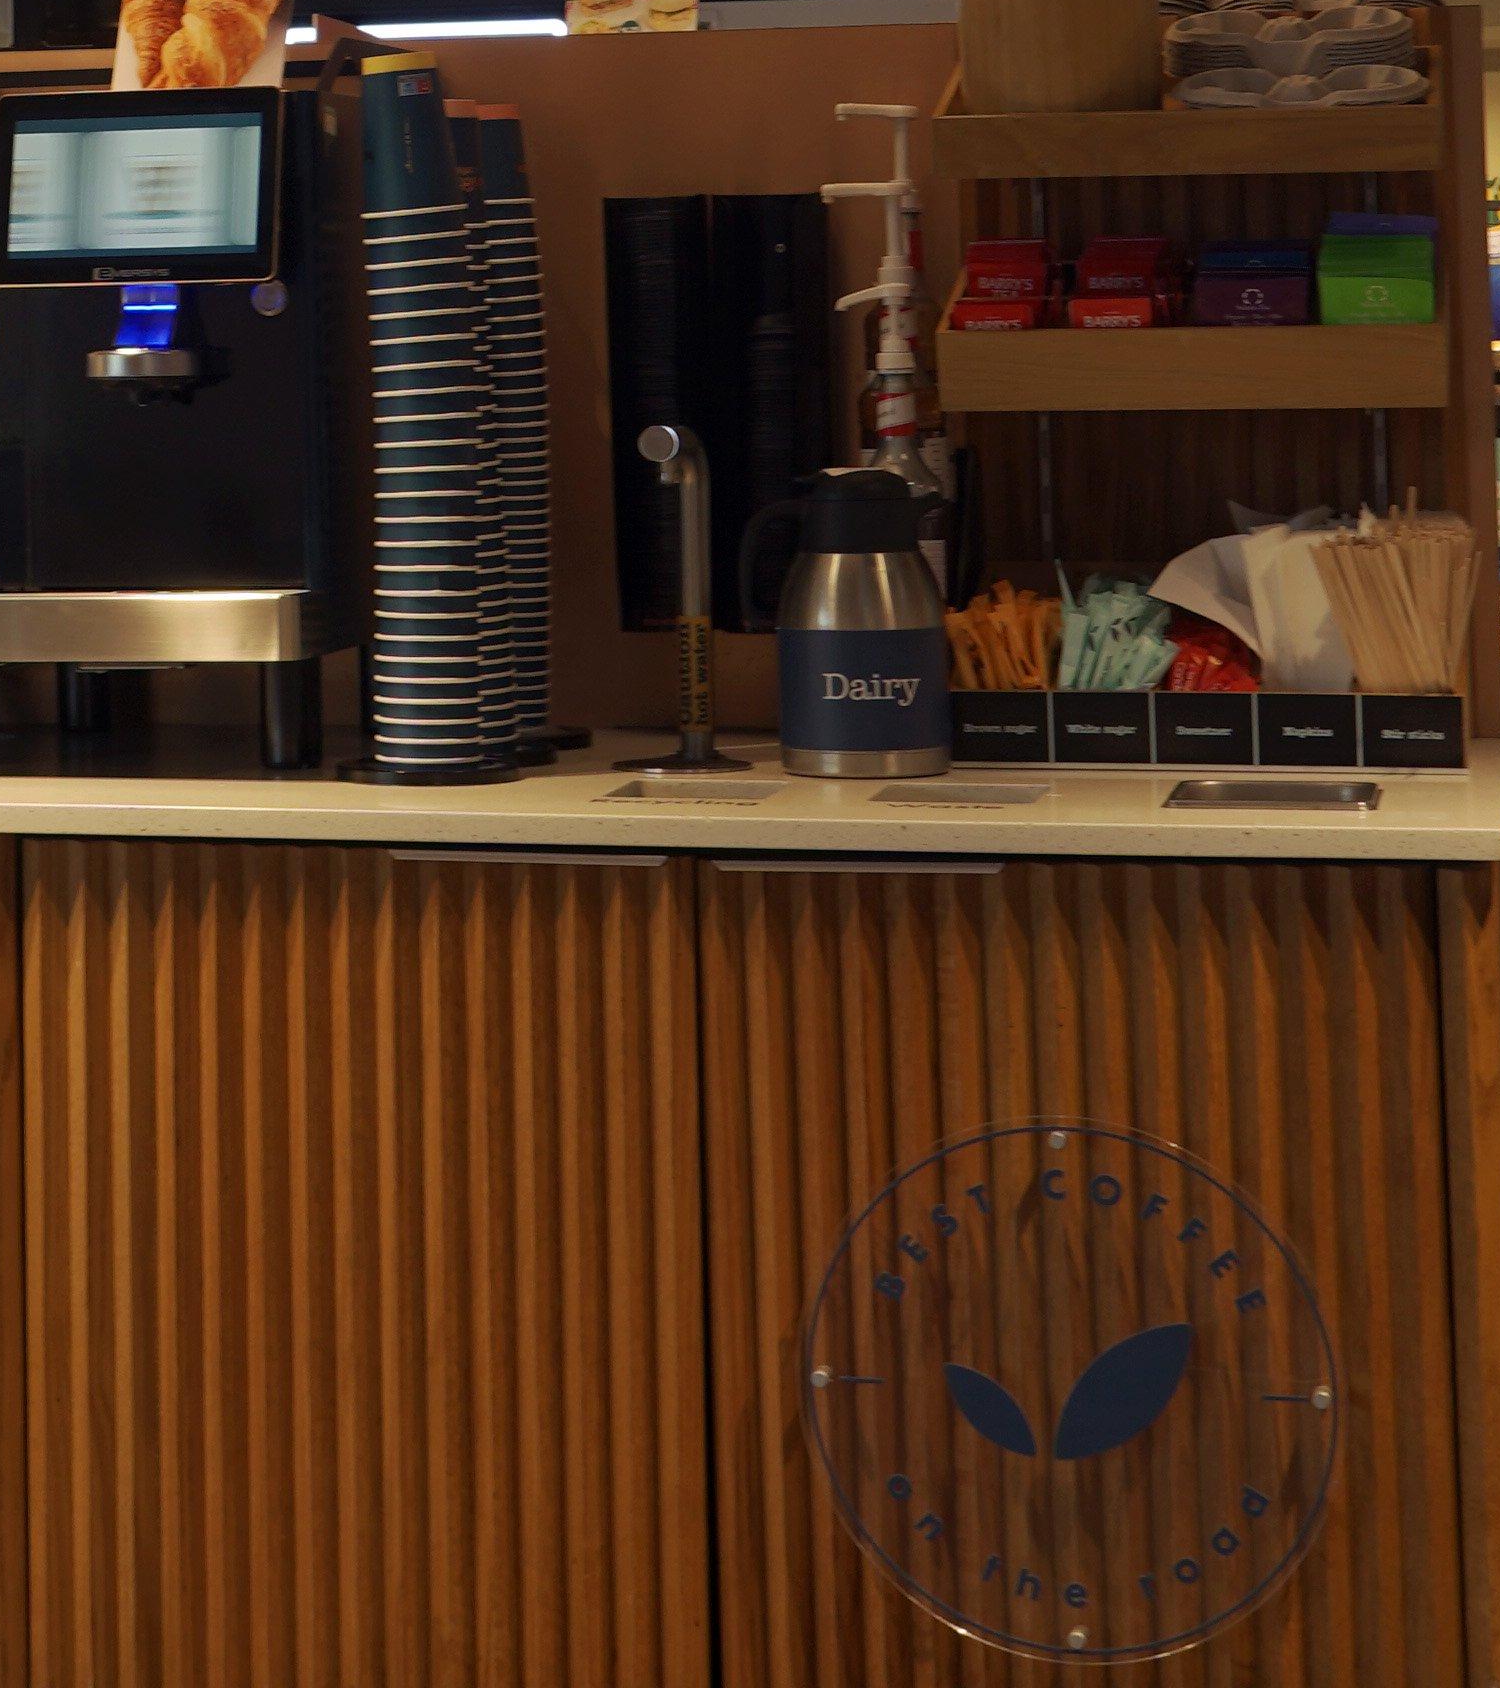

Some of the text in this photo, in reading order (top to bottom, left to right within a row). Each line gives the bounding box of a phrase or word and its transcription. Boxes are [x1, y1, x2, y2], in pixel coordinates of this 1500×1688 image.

[820, 671, 922, 707] Dairy
[874, 1168, 1268, 1314] BEST COFFEE
[888, 1474, 1272, 1610] on the road
